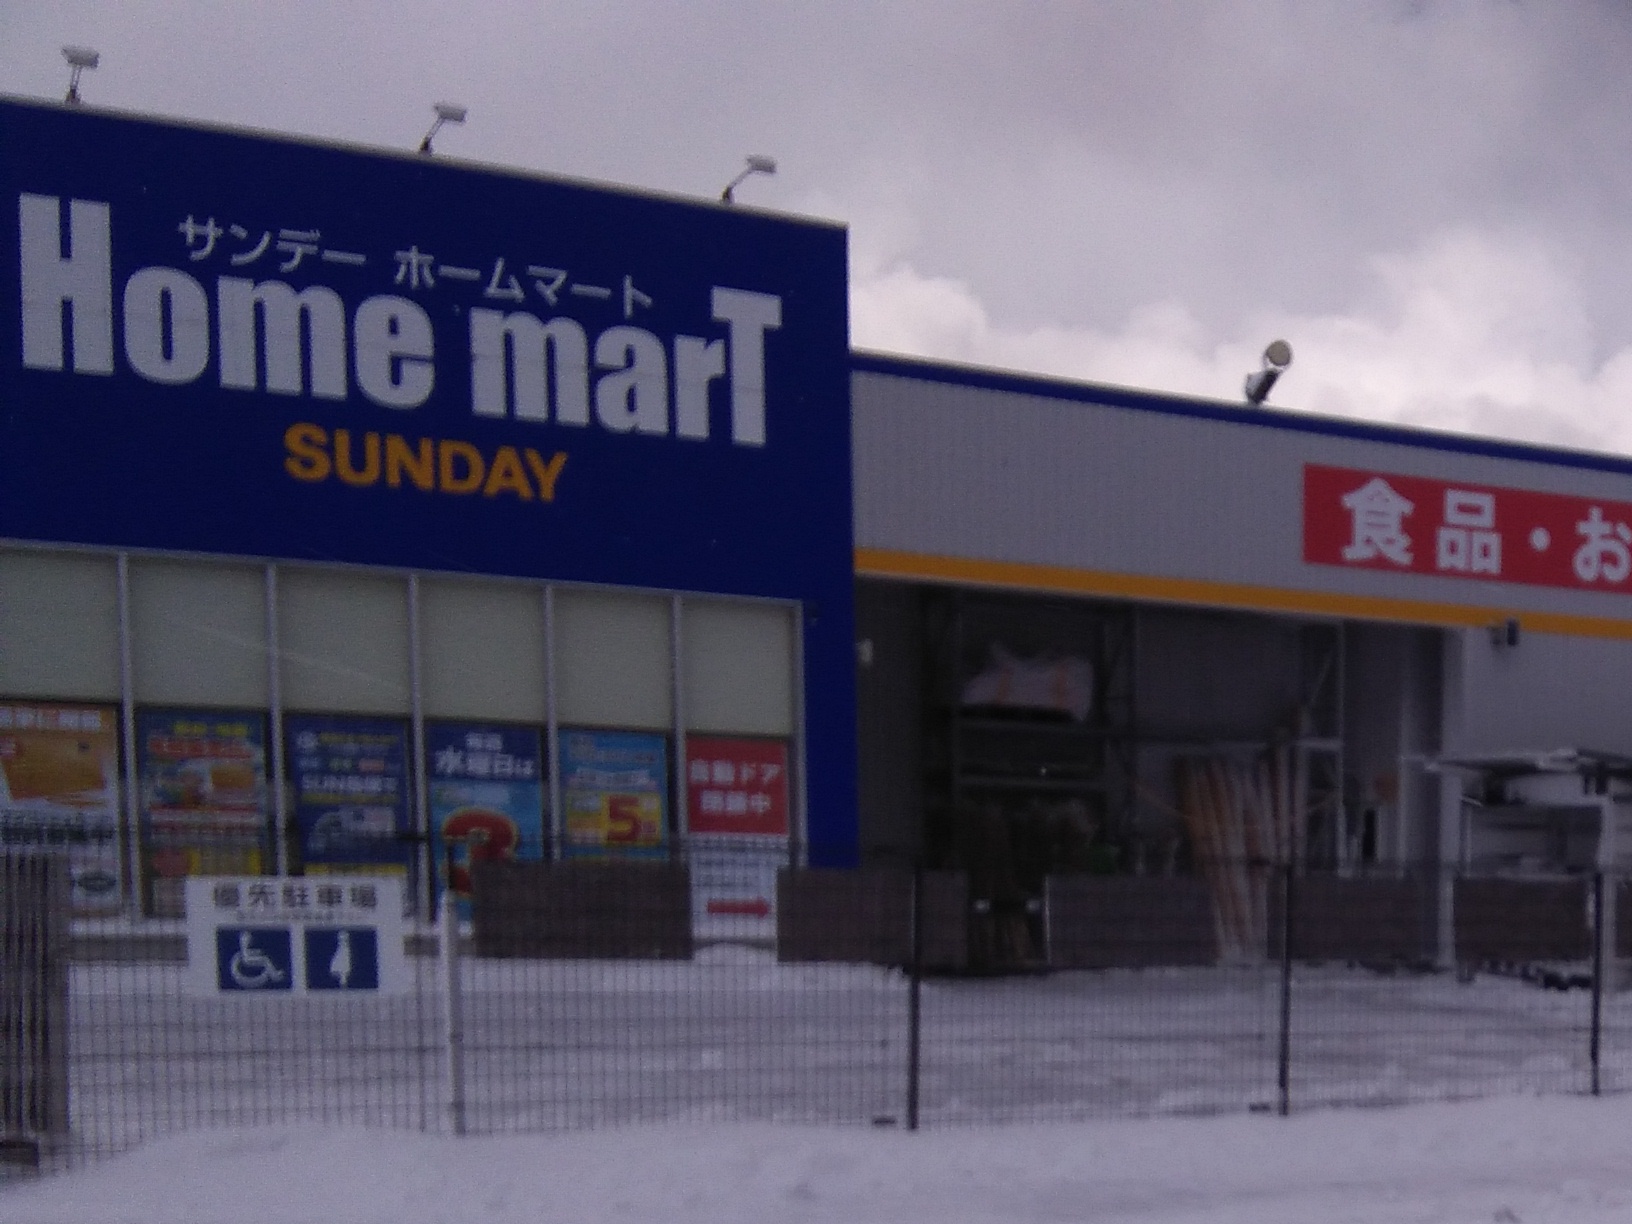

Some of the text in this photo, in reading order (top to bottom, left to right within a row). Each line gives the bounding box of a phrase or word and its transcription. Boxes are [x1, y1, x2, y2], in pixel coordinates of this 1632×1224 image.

[18, 192, 436, 409] Home
[179, 214, 653, 316] サンデー ホームマート
[283, 422, 568, 502] SUNDAY
